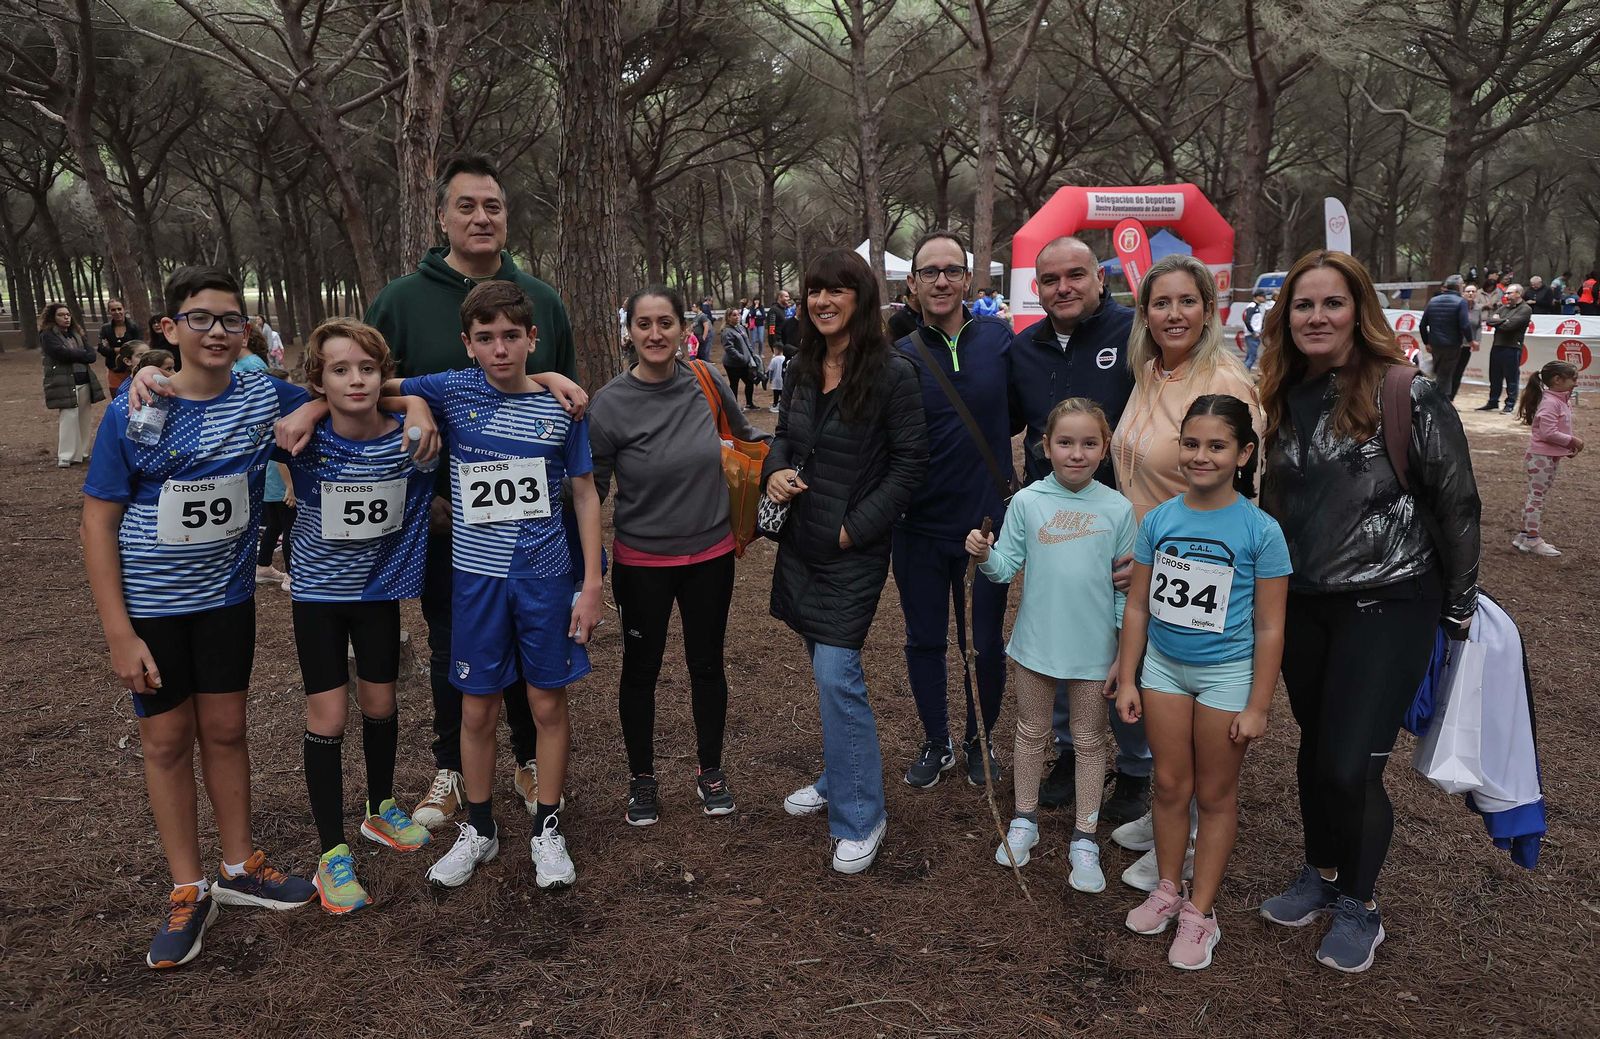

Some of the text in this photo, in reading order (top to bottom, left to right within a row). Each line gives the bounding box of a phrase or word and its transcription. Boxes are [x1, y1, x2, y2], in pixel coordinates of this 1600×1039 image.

[1135, 195, 1144, 204] de
[1145, 196, 1176, 205] Deportes
[474, 447, 520, 460] ATLETISMO
[473, 464, 509, 473] CROSS
[172, 483, 215, 493] CROSS
[335, 485, 373, 493] CROSS
[470, 477, 540, 508] 203
[181, 497, 232, 529] 59
[343, 499, 388, 525] 58
[1047, 509, 1097, 530] NIKE
[1189, 544, 1213, 553] C.A.L.
[1161, 556, 1191, 571] CROSS
[1153, 572, 1217, 614] 234
